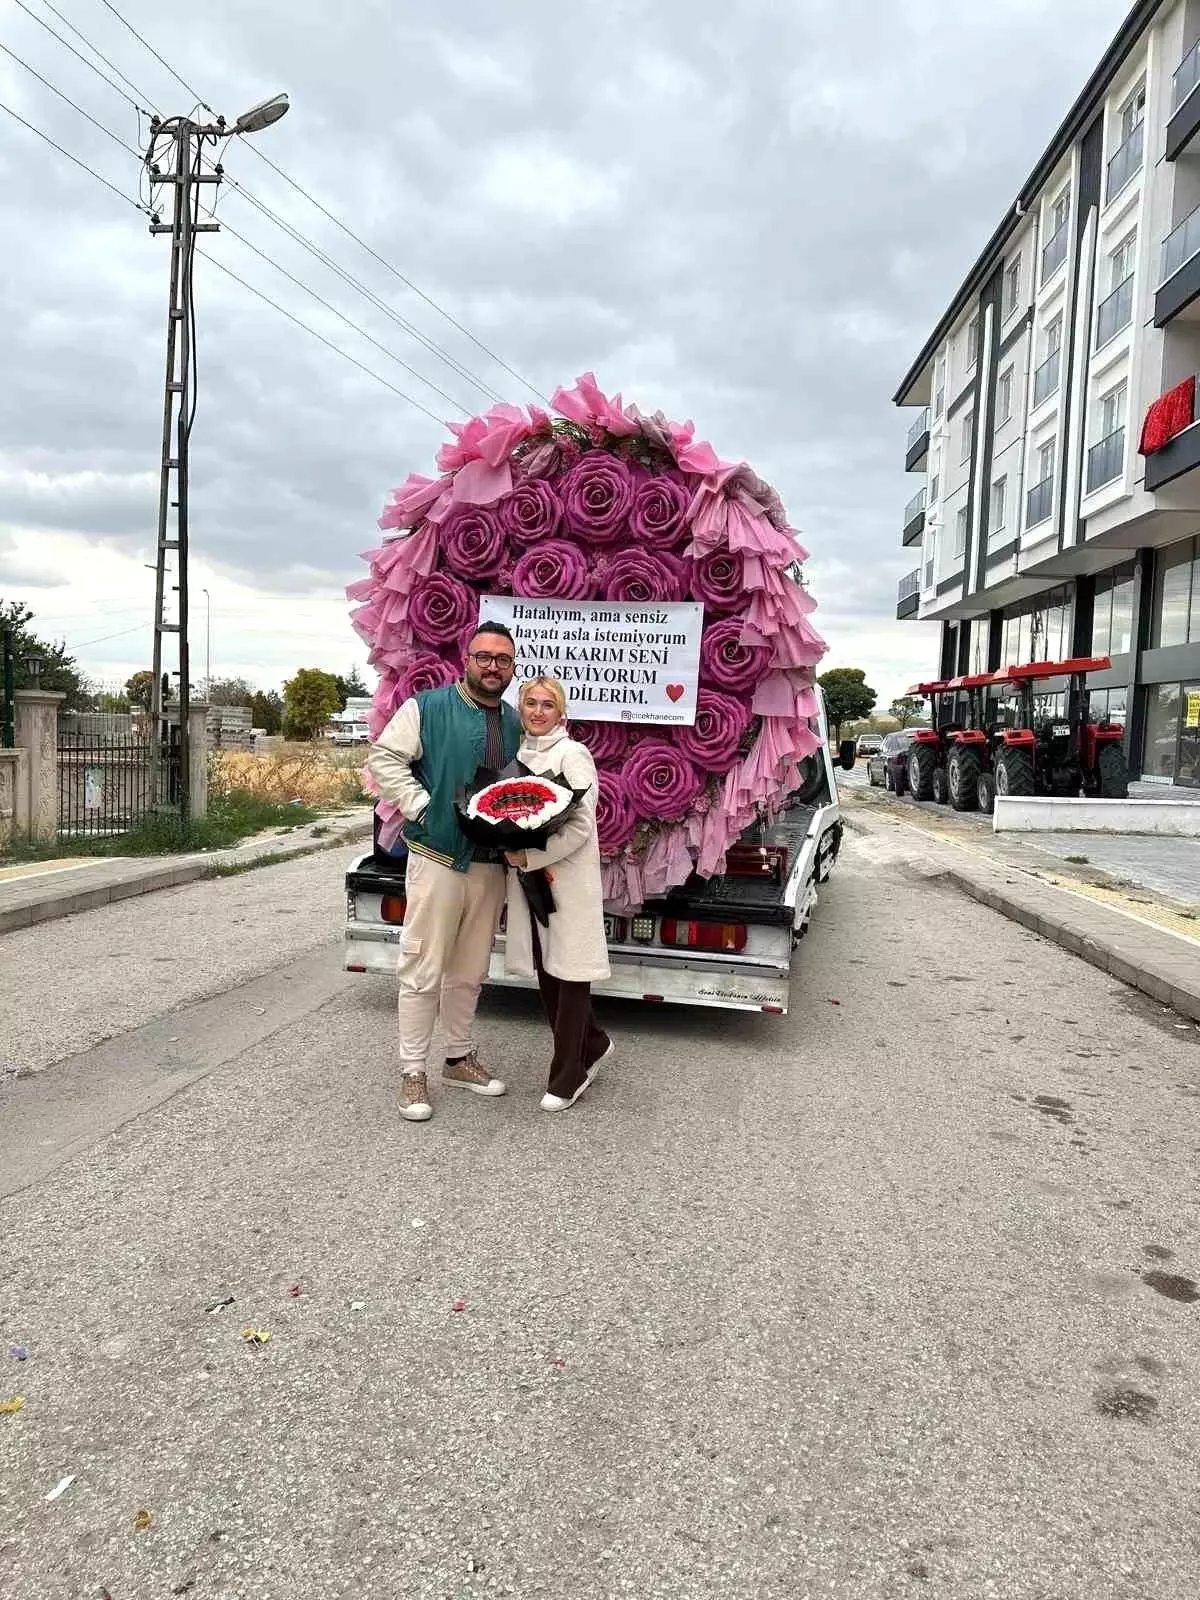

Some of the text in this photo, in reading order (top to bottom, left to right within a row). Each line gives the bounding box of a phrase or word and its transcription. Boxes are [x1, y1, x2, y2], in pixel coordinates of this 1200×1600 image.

[513, 605, 669, 624] Hatalıyım, ama sensiz
[515, 625, 686, 647] hayatı asla istemiyorum
[516, 645, 669, 664] ANIM KARIM SENİ
[514, 663, 657, 684] ÇOK SEVİYORUM
[569, 683, 649, 704] DİLERİM.
